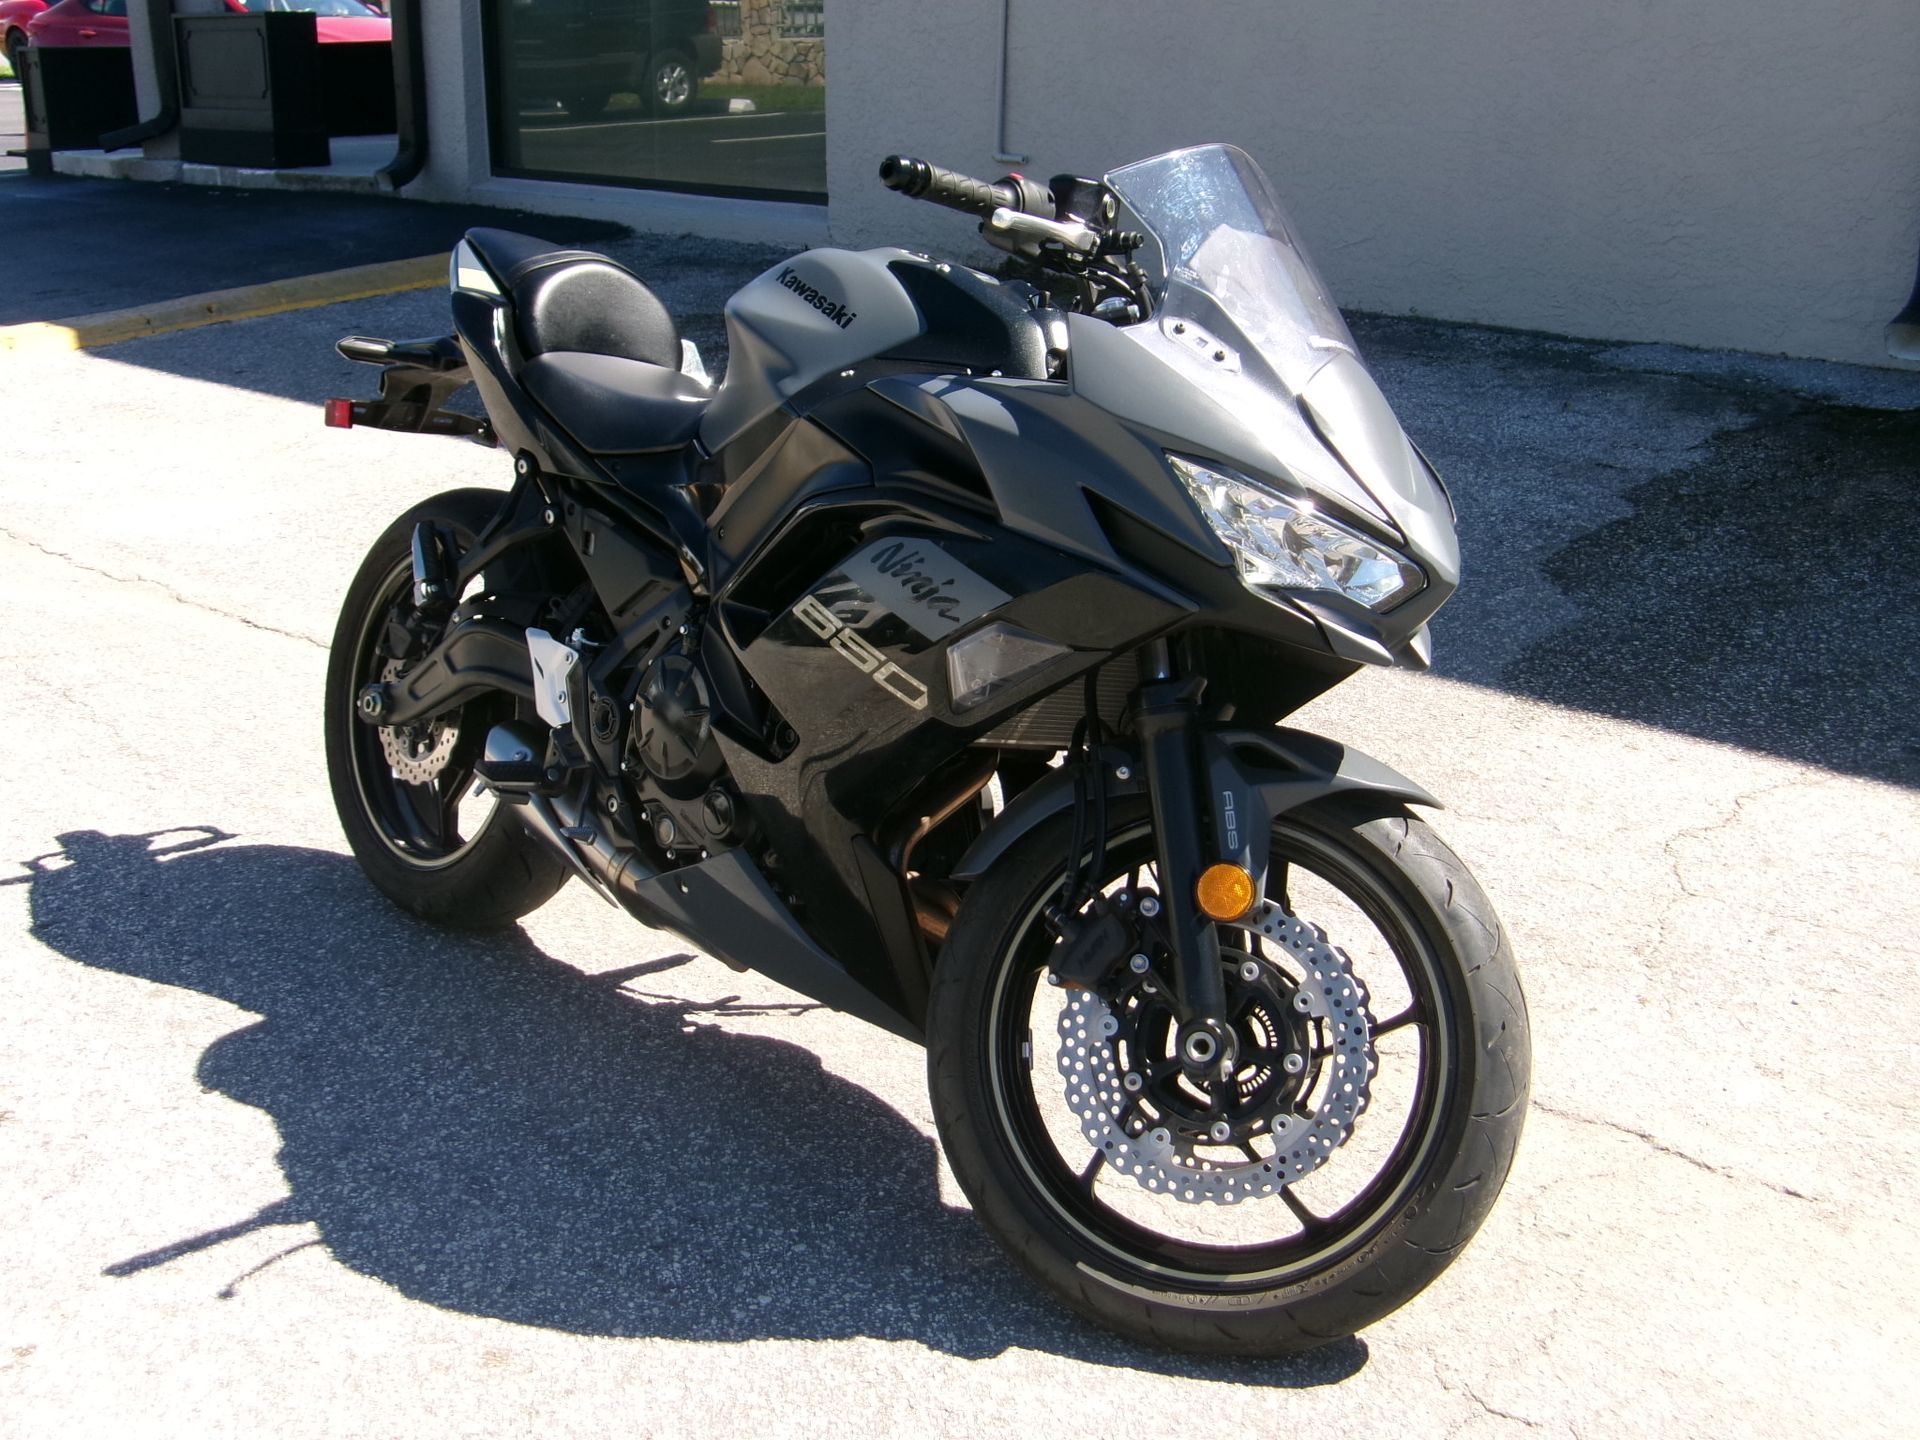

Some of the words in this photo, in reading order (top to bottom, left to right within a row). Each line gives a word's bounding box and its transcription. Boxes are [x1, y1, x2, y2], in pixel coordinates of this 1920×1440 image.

[776, 266, 857, 330] Kawasaki
[870, 541, 961, 623] Ninja
[791, 594, 929, 711] 650
[1222, 790, 1239, 850] ABS
